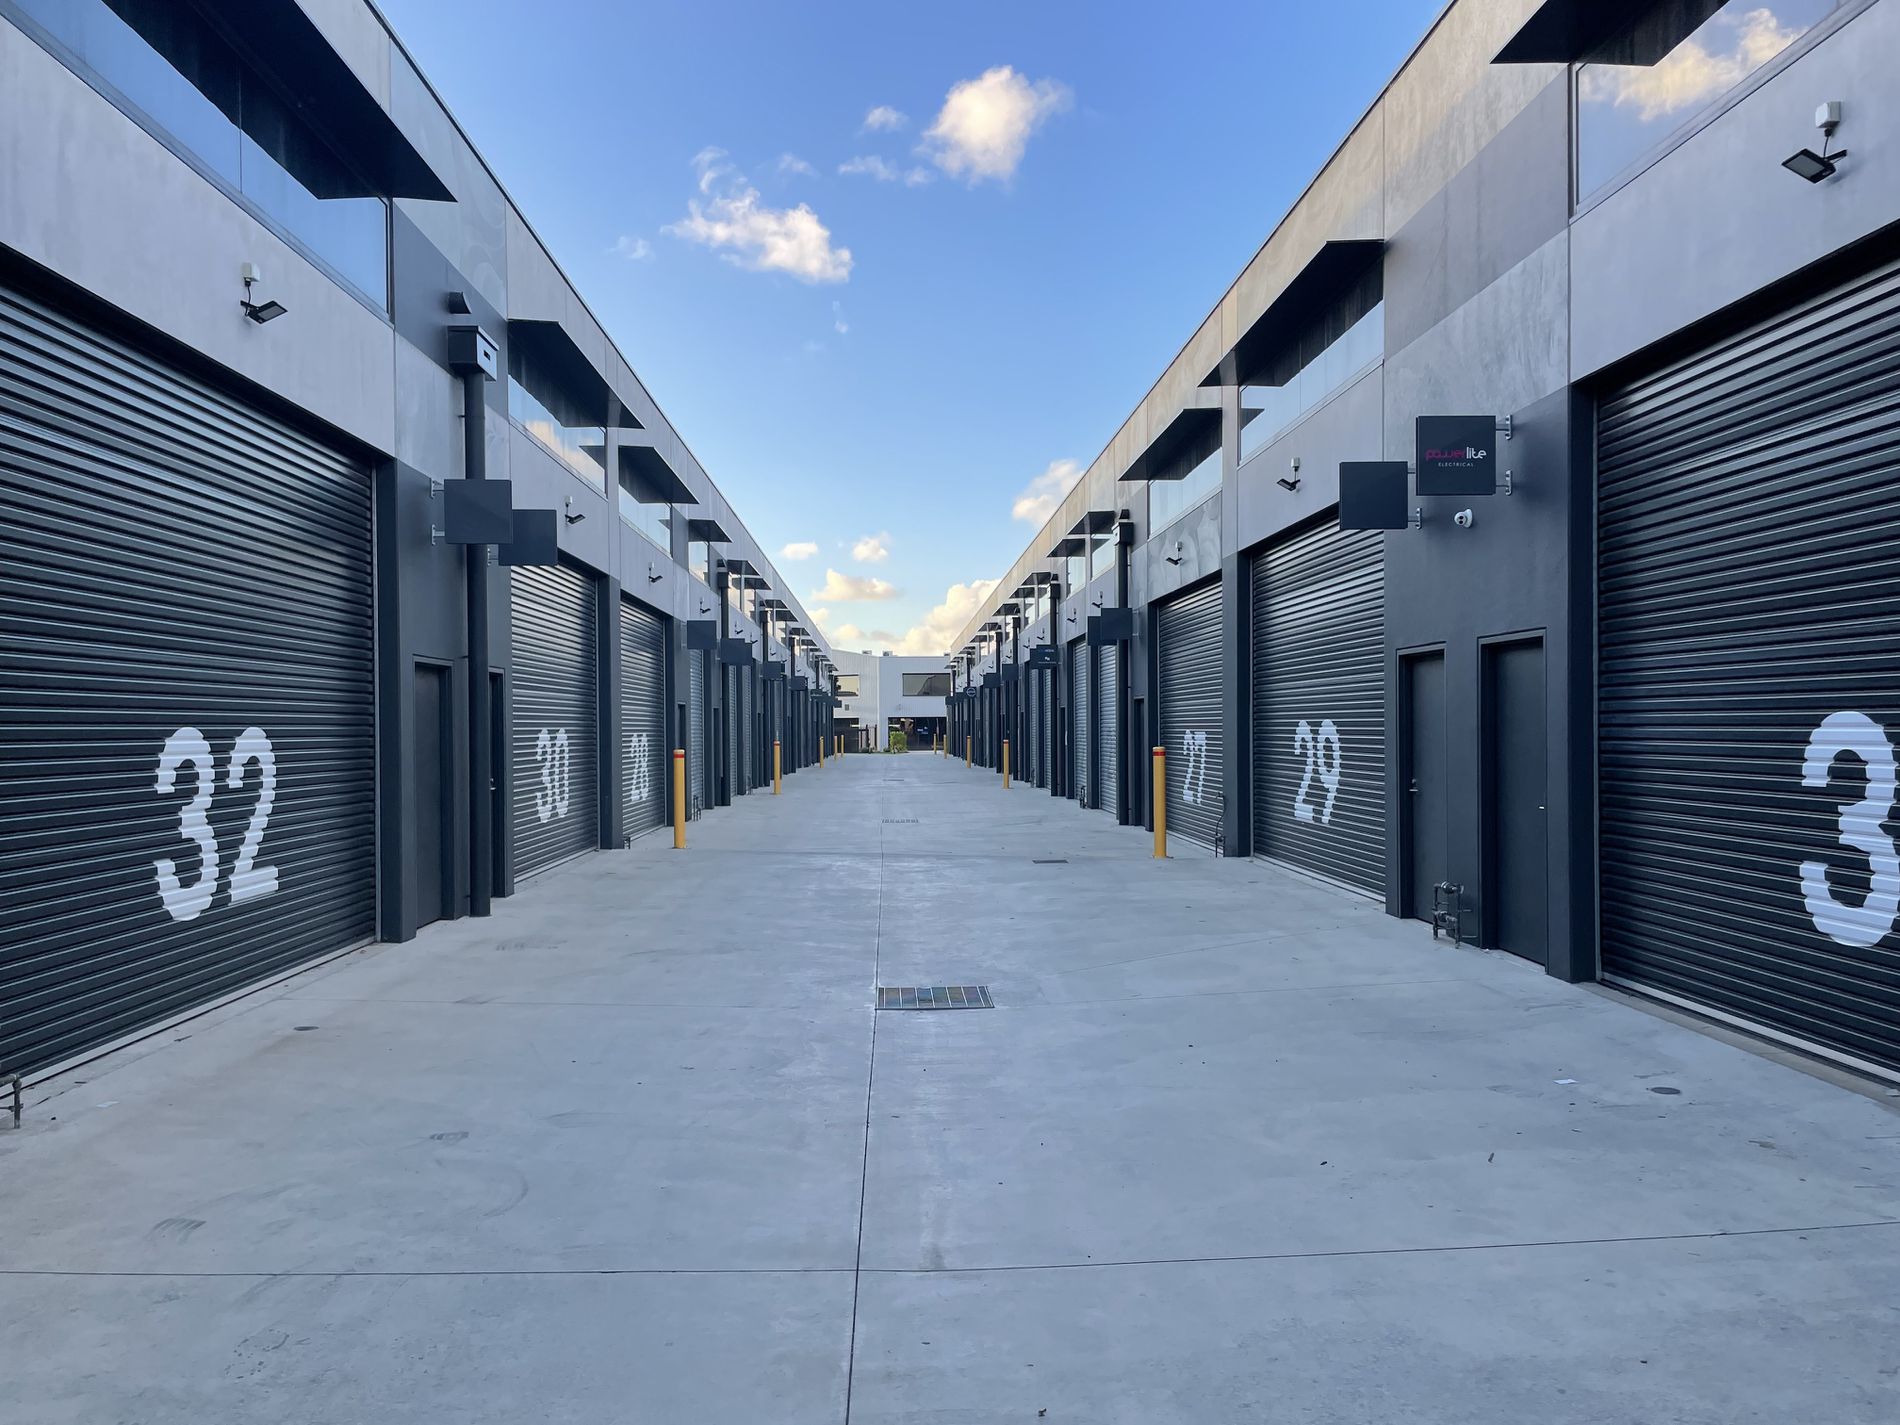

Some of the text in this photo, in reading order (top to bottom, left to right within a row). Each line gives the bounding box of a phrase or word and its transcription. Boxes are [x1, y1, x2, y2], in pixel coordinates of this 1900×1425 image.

[1425, 446, 1487, 461] powerlite
[536, 728, 569, 823] 30
[1183, 729, 1207, 804] 27
[1294, 719, 1341, 824] 29
[154, 727, 279, 921] 32
[1800, 711, 1900, 947] 3
